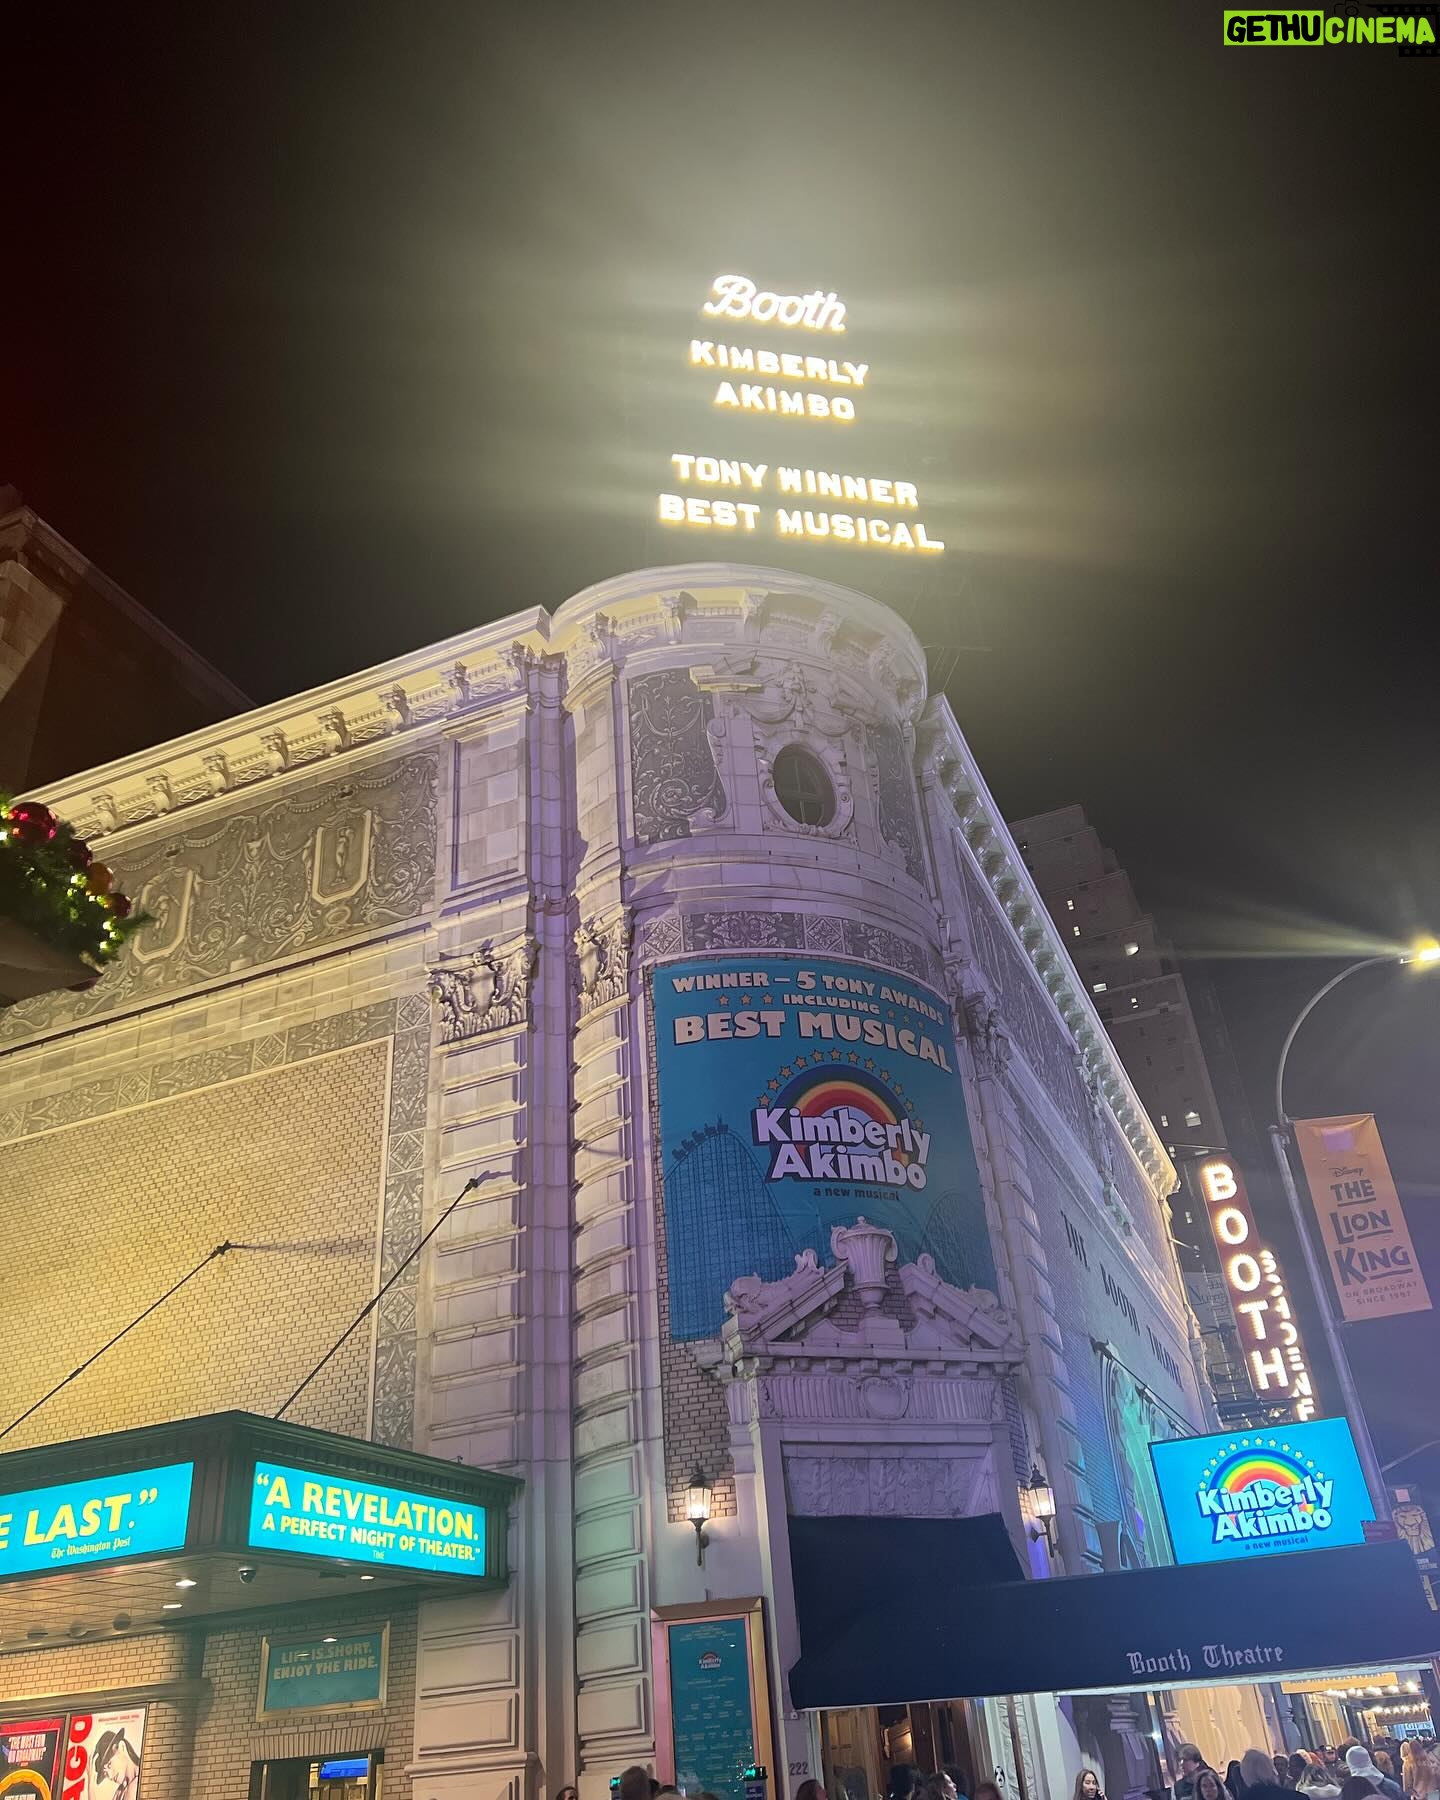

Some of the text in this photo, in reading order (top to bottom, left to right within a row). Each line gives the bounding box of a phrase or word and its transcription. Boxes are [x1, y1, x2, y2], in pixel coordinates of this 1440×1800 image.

[703, 274, 847, 332] Booth
[690, 339, 869, 386] KIMBERLY
[714, 381, 855, 420] AKIMBO
[671, 453, 919, 507] TONY WINNER
[658, 493, 945, 550] BEST MUSICAL
[671, 971, 770, 994] WINNER
[796, 970, 816, 991] 5
[822, 974, 876, 998] TONY
[880, 985, 945, 1027] AWARDS
[783, 993, 880, 1016] INCLUDING
[674, 1010, 953, 1074] BEST MUSICAL
[754, 1106, 931, 1165] Kimberly
[769, 1142, 928, 1191] Akimbo
[813, 1185, 900, 1201] a new musical
[1330, 1179, 1375, 1202] THE
[1329, 1209, 1392, 1245] LION
[1202, 1161, 1290, 1391] BOOTH
[1334, 1245, 1412, 1287] KING
[1356, 1294, 1386, 1305] SINCE
[1363, 1280, 1418, 1296] BROADWAY
[301, 1481, 479, 1541] REVELATION.
[1197, 1475, 1334, 1516] Kimberly
[261, 1513, 276, 1531] A
[280, 1515, 347, 1542] PERFECT
[350, 1526, 396, 1550] NIGHT
[399, 1534, 416, 1552] OF
[1214, 1503, 1333, 1543] Akimbo
[51, 1536, 131, 1559] The Washington Post
[1253, 1541, 1271, 1550] new
[1274, 1536, 1309, 1547] musical
[273, 1664, 313, 1680] ENJOY
[315, 1660, 341, 1676] THE
[311, 1648, 325, 1661] IS
[1126, 1643, 1285, 1674] Booth Theatre
[789, 1762, 809, 1776] 222
